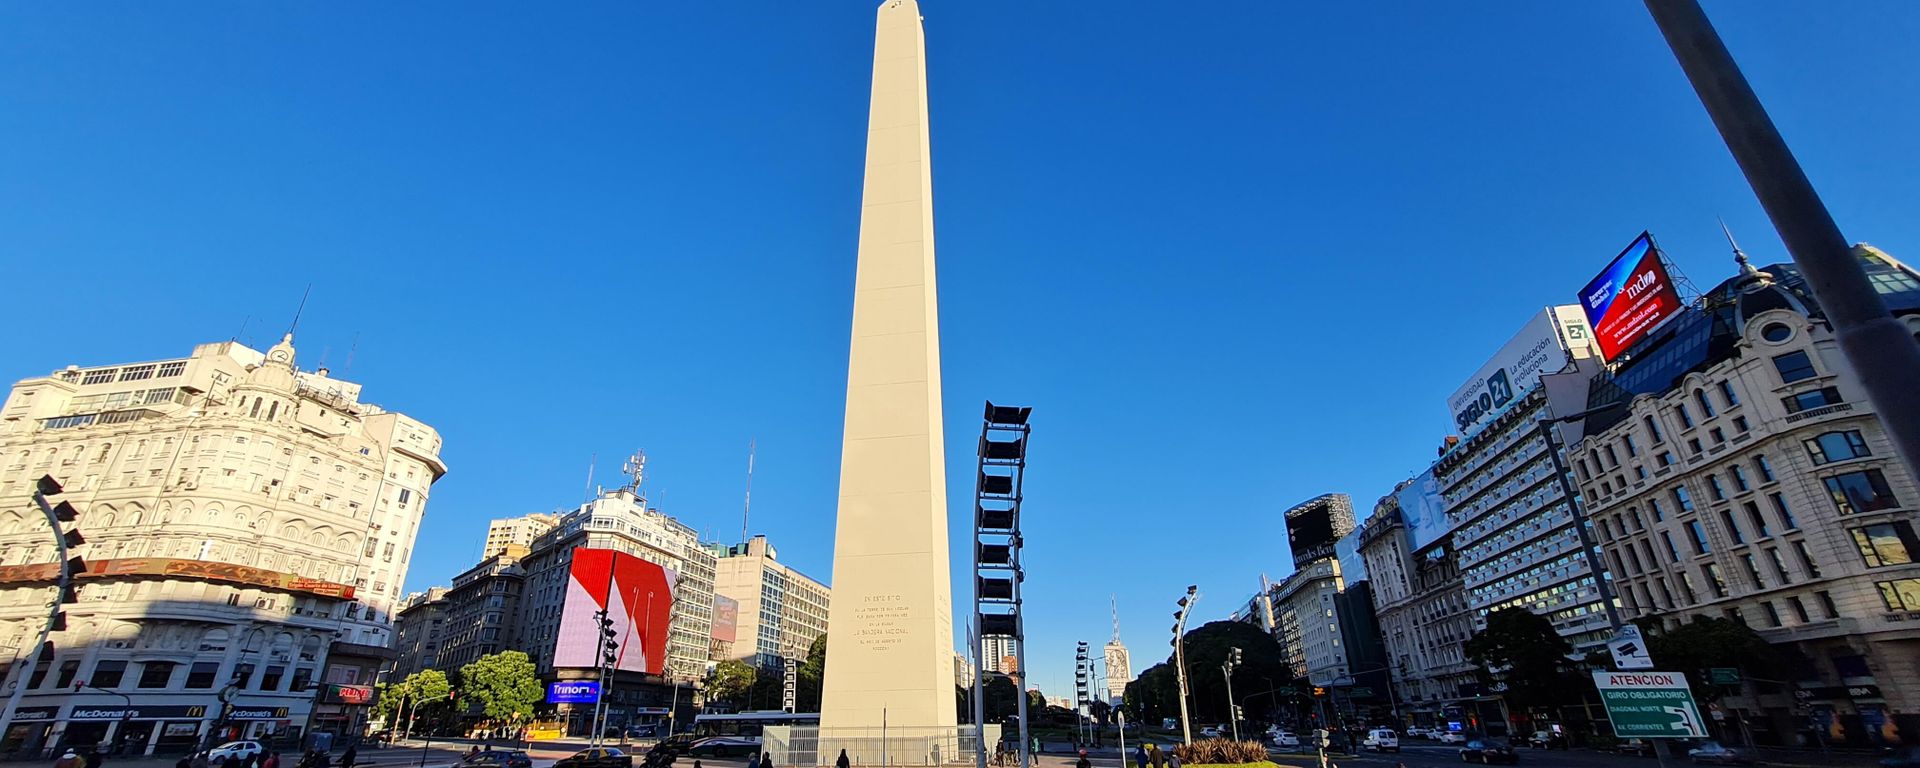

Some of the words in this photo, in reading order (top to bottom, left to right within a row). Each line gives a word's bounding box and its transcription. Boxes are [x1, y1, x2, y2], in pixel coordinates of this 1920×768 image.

[1591, 290, 1610, 309] Global
[1570, 327, 1585, 339] 21
[1509, 364, 1517, 376] La
[1517, 336, 1551, 369] educación
[1513, 353, 1548, 386] evoluciona
[1453, 377, 1485, 410] UNIVERSIDAD
[1456, 392, 1492, 432] SIGLO
[1491, 379, 1508, 400] 21
[1610, 675, 1674, 685] ATENCION
[1607, 691, 1629, 699] GIRO
[1630, 691, 1687, 699] OBLIGATORIO
